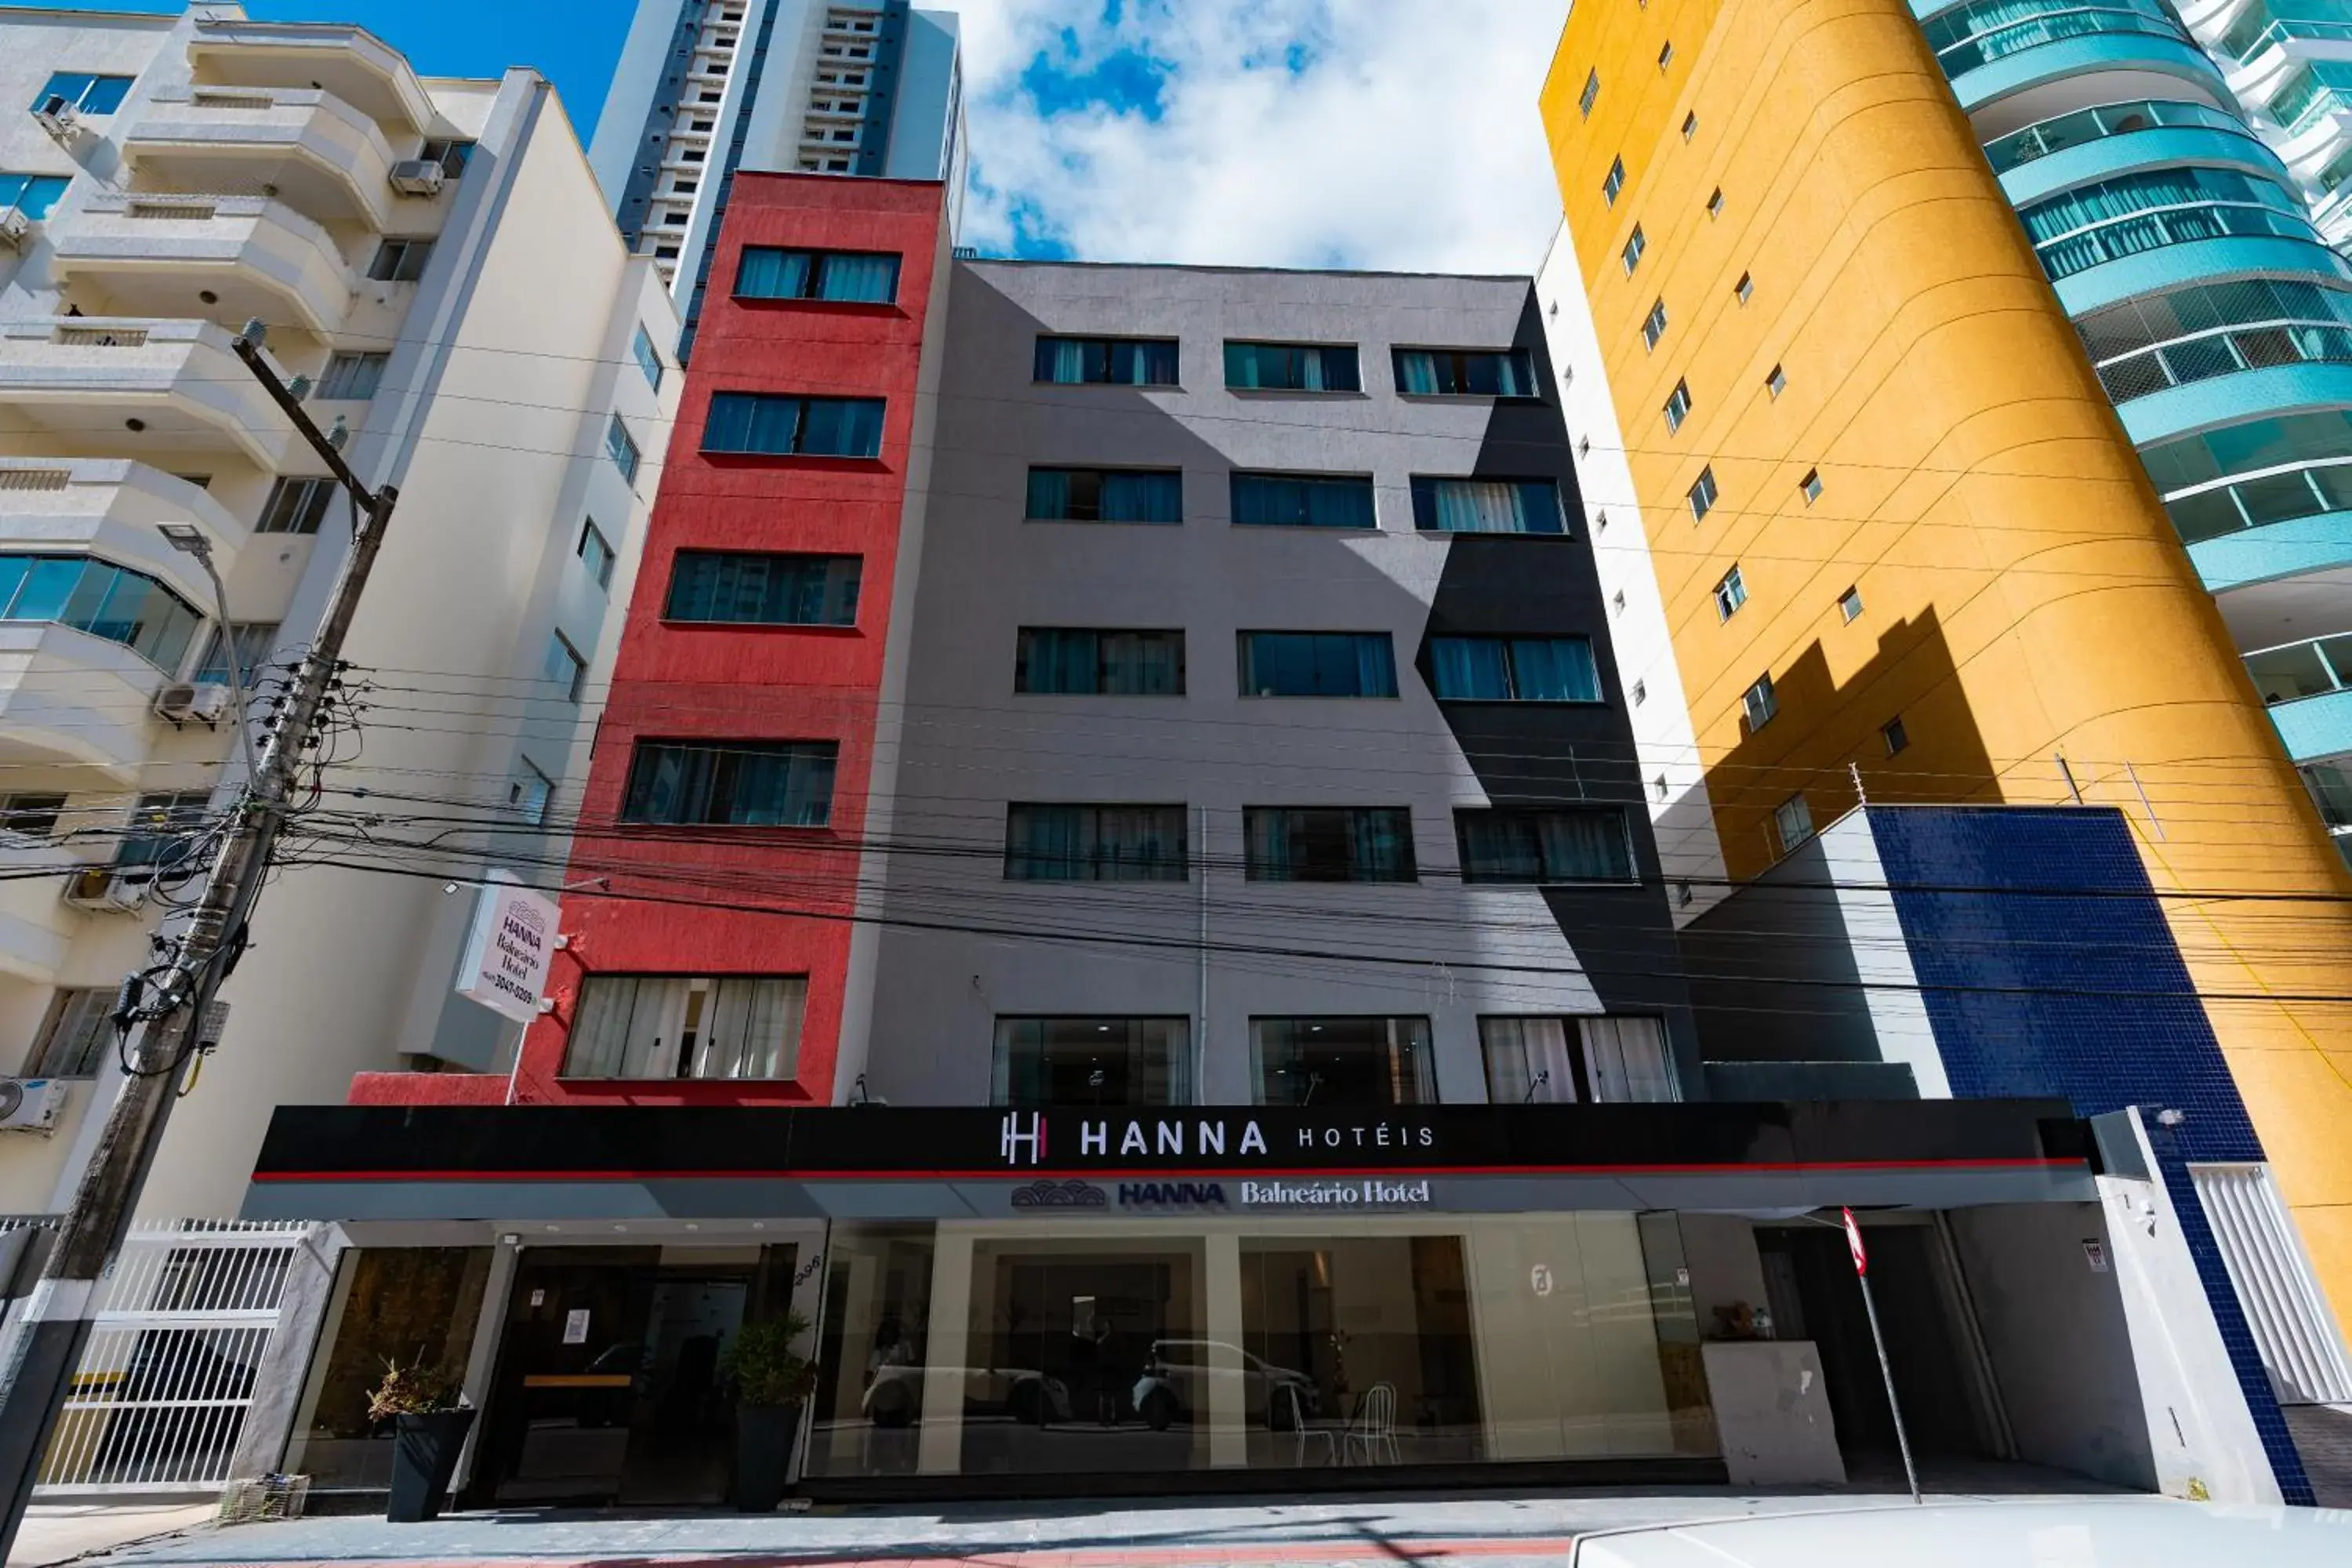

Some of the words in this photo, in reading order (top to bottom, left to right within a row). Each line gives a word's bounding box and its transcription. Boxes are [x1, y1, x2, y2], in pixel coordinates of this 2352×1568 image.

[503, 916, 541, 952] HANNA
[502, 954, 528, 980] Hotel
[1081, 1120, 1268, 1155] HANNA
[1298, 1122, 1433, 1147] HOTÉIS
[1118, 1182, 1225, 1205] HANNA
[1241, 1181, 1359, 1204] Balneário
[1363, 1179, 1430, 1203] Hotel
